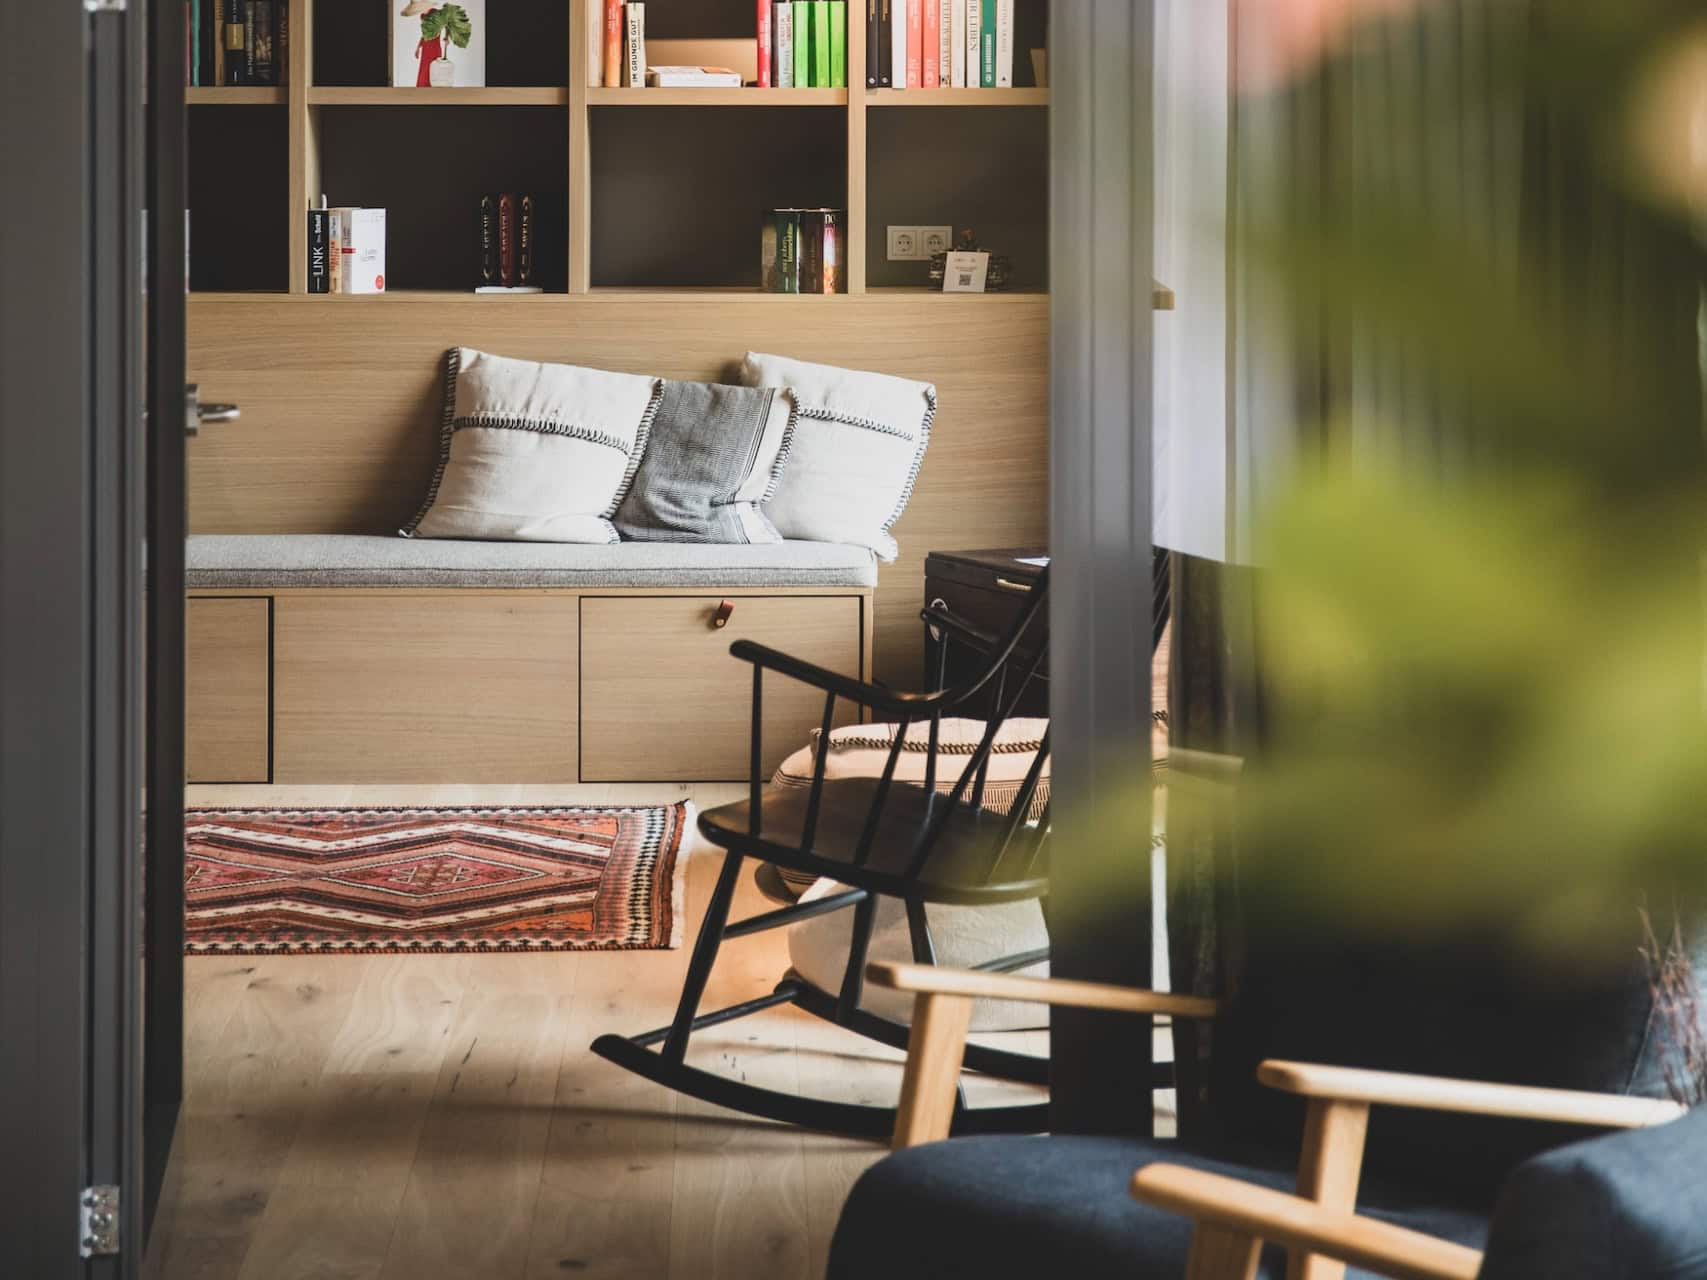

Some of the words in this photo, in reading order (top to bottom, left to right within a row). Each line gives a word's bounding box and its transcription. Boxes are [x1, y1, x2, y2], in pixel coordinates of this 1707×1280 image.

[969, 16, 977, 52] LEBEN
[631, 73, 638, 83] IM
[312, 246, 324, 276] LINK
